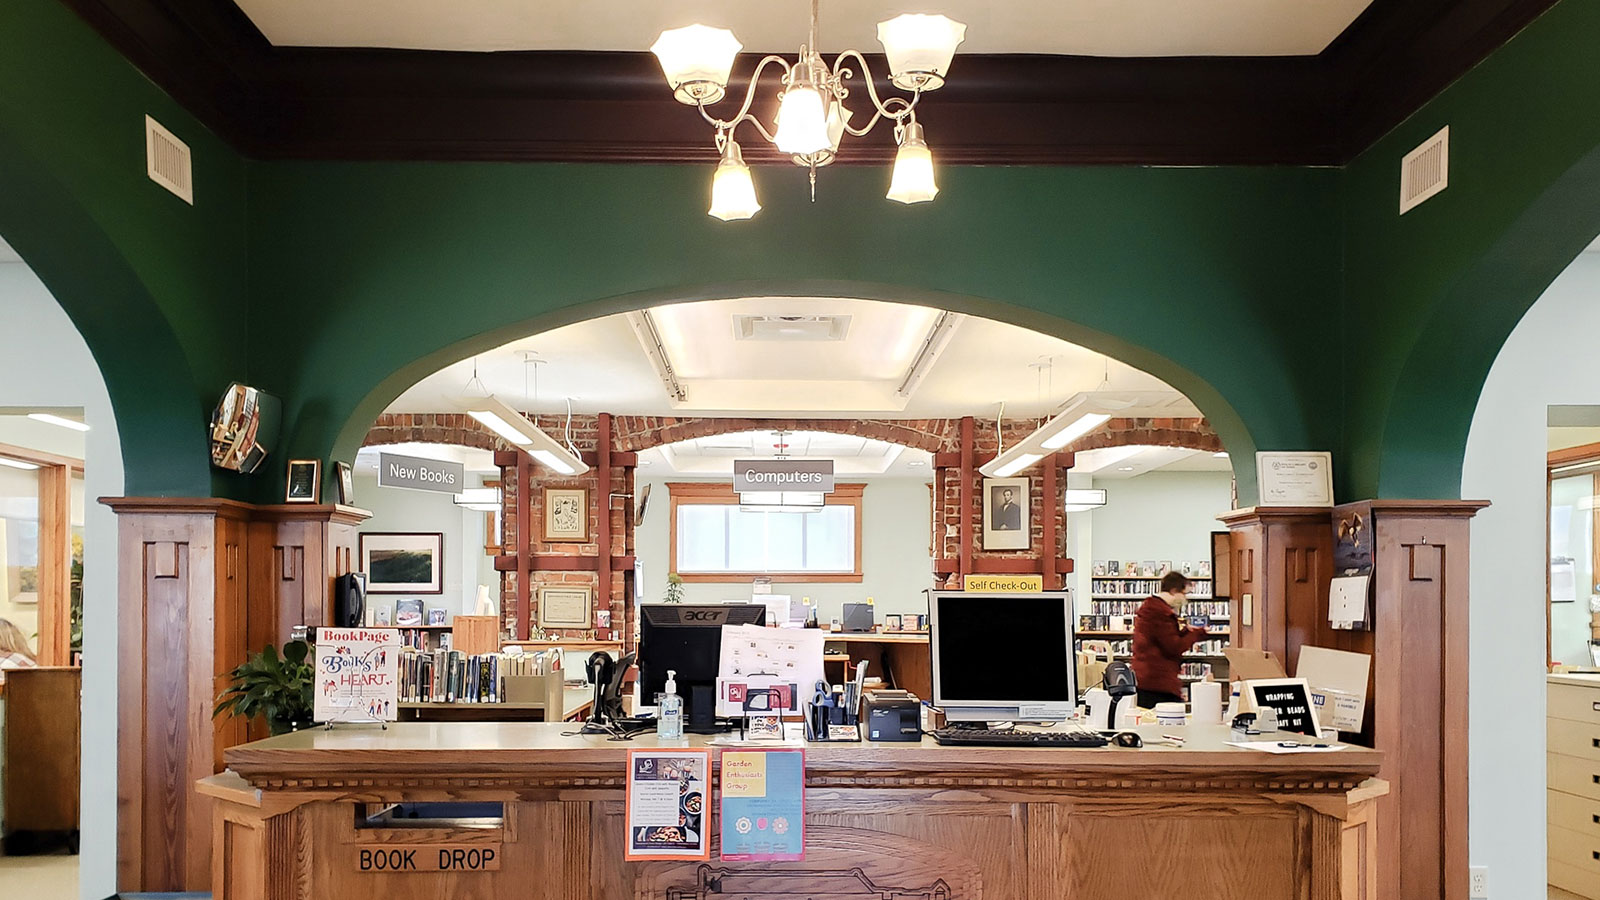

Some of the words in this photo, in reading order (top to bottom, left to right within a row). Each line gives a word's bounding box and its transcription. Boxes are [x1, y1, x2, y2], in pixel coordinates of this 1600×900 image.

[390, 463, 416, 479] New
[420, 467, 455, 484] Books
[745, 469, 822, 485] Computers
[970, 581, 987, 590] Self
[989, 581, 1037, 590] Check-Out
[684, 611, 722, 621] acer
[324, 631, 390, 644] BookPage
[340, 673, 387, 686] HEART
[1265, 693, 1294, 701] WRAPPING
[1287, 706, 1306, 714] BEADS
[1277, 719, 1289, 727] AFT
[1292, 718, 1302, 726] KIT
[360, 850, 417, 870] BOOK
[439, 849, 495, 870] DROP
